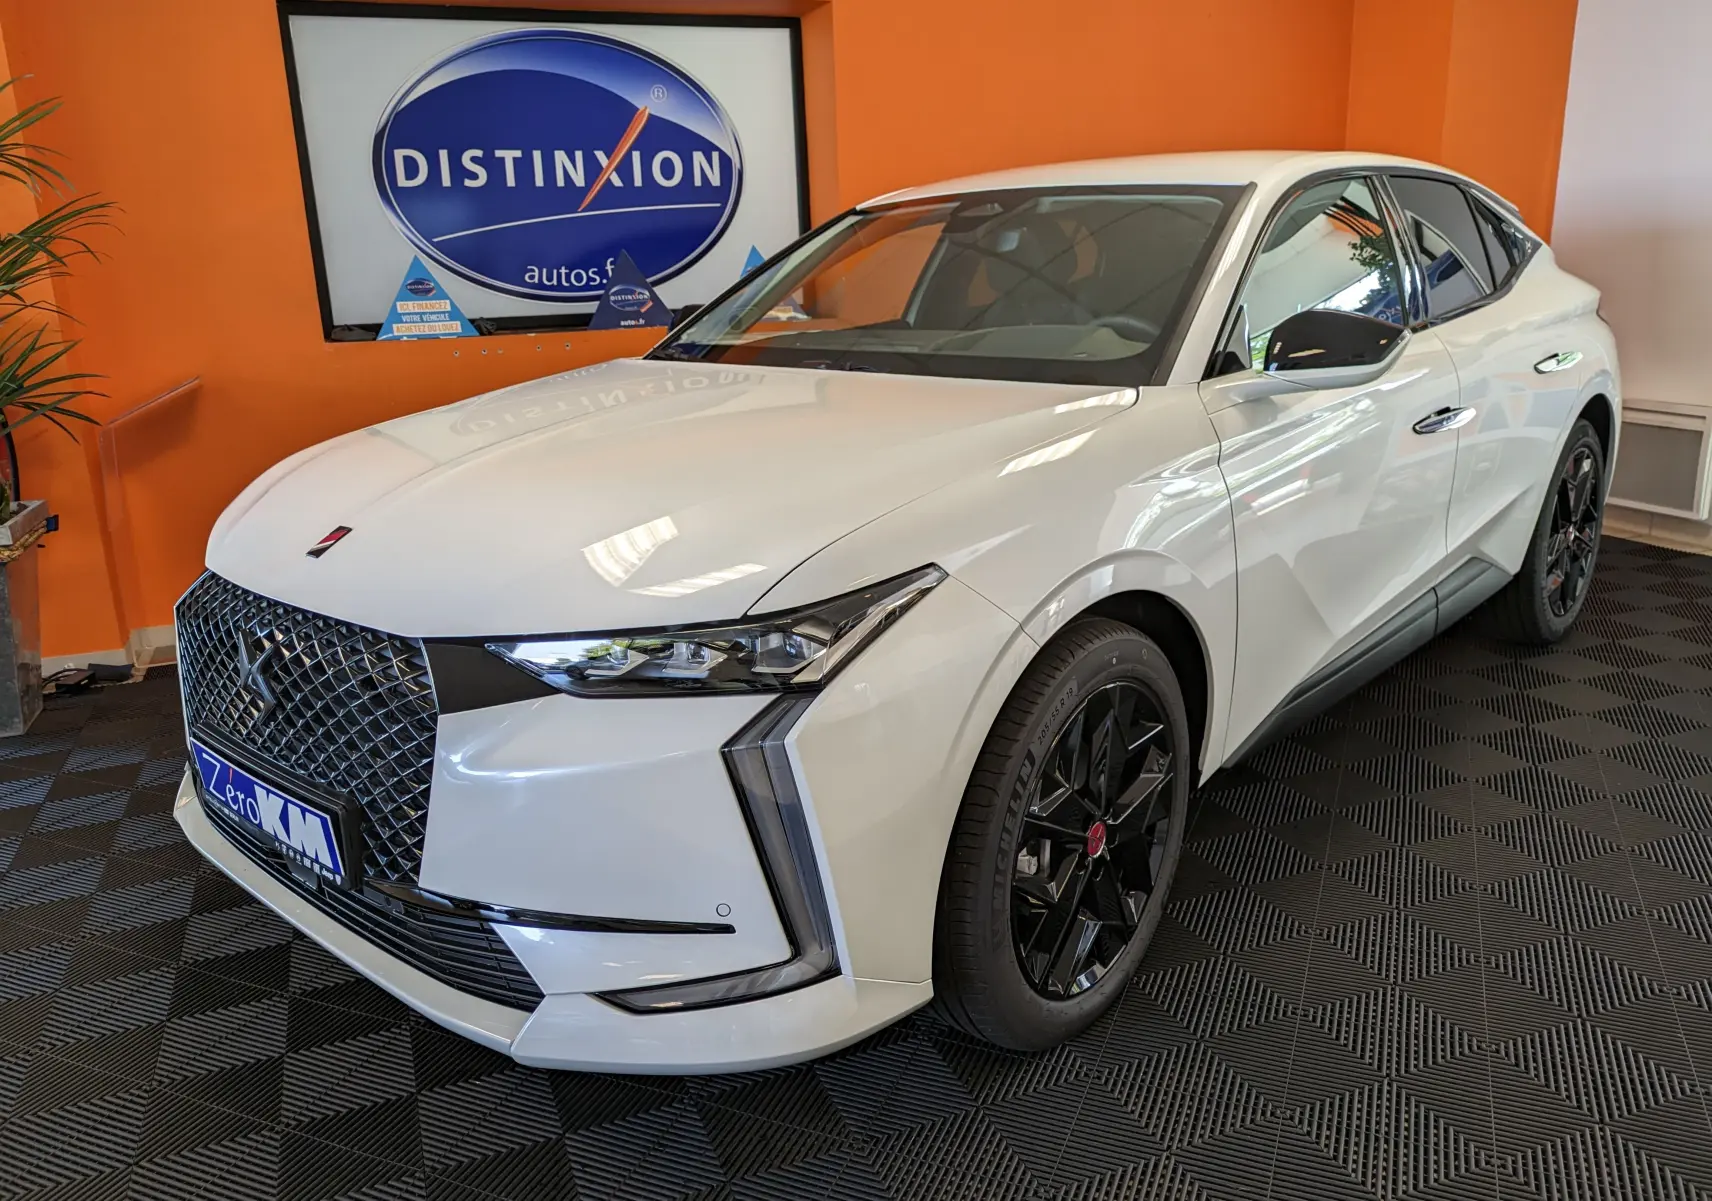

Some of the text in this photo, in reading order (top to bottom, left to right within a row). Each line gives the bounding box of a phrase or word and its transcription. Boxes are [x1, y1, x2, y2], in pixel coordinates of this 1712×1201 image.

[393, 148, 722, 189] DISTINXION
[524, 258, 615, 287] autos.f
[396, 323, 459, 334] ACHETEZ OU LOUEZ
[402, 313, 450, 322] VOTRE VÉHICULE
[620, 318, 645, 326] autos.fr
[1038, 705, 1059, 745] 205/55
[1060, 698, 1065, 708] R
[991, 749, 1036, 923] MICHELIN
